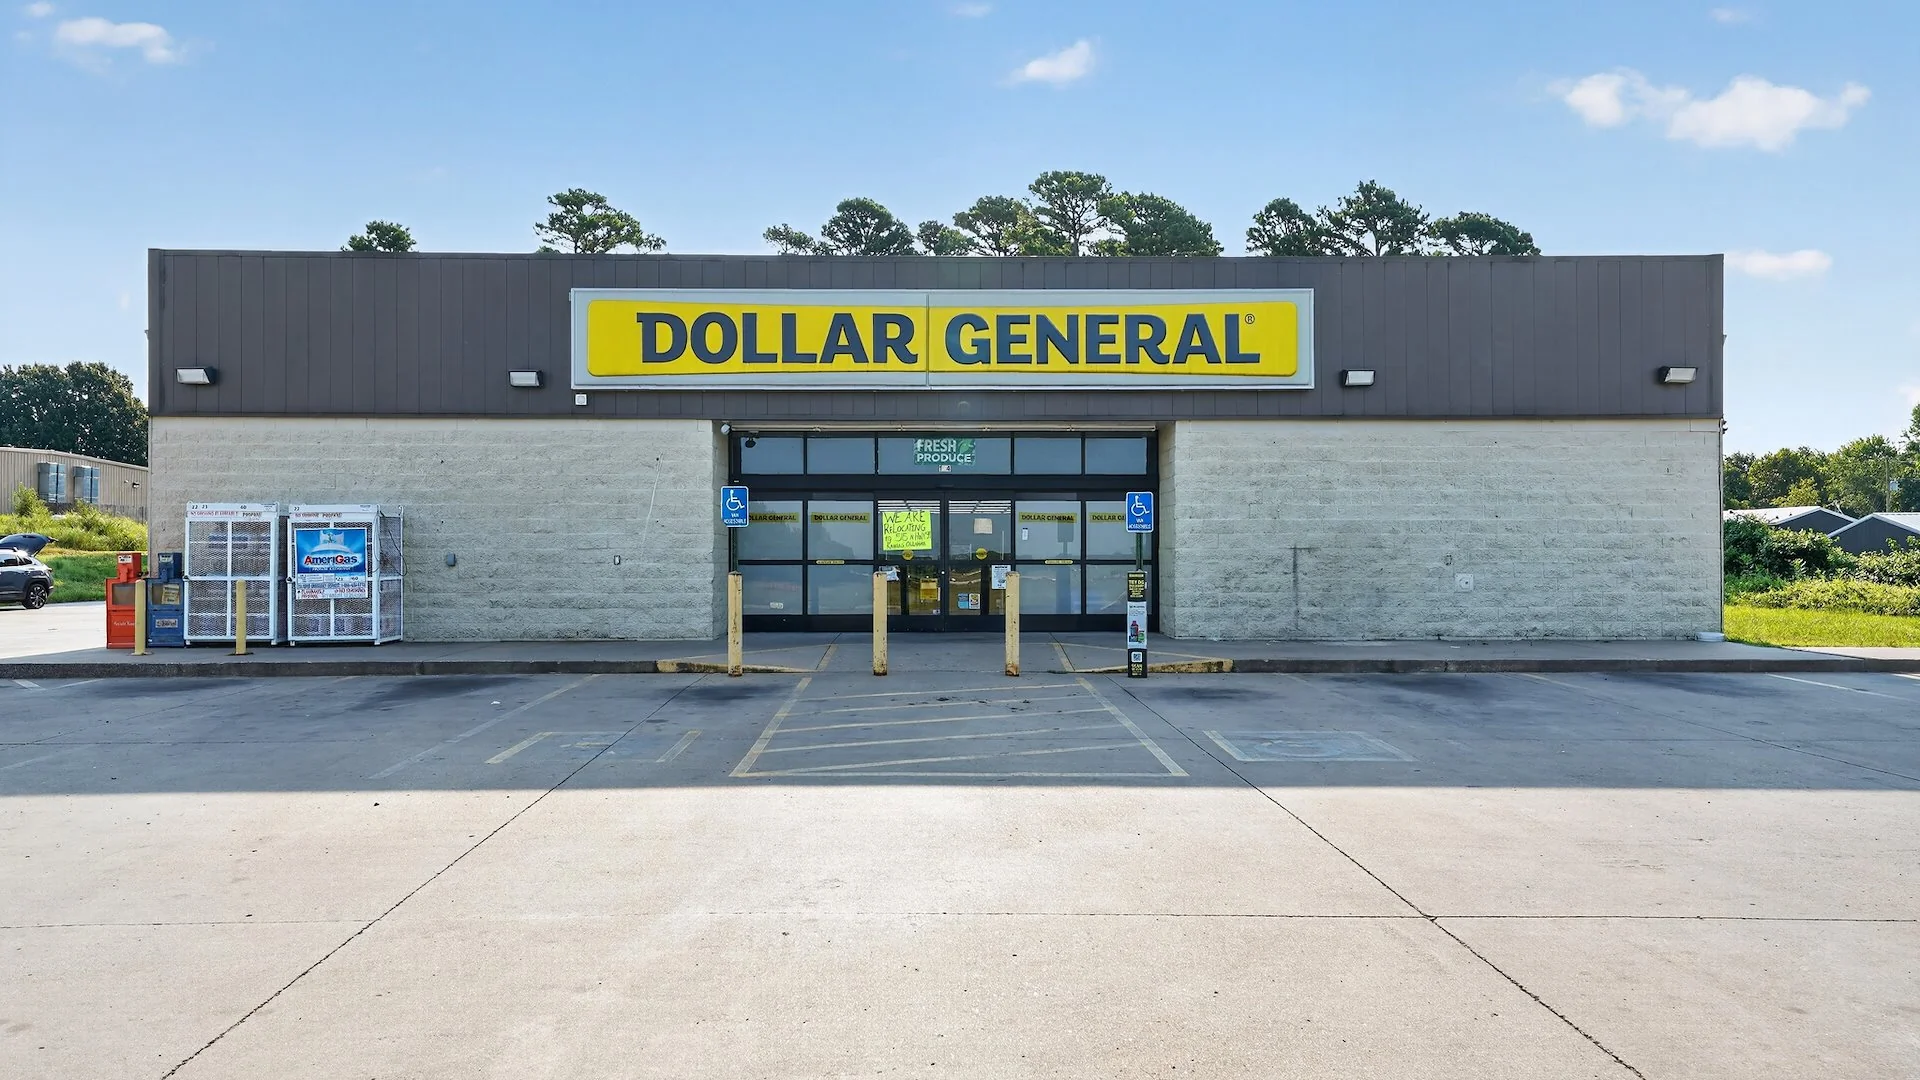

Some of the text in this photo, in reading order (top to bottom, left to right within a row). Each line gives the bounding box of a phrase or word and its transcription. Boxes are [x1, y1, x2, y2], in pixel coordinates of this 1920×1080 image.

[636, 311, 1261, 365] DOLLAR GENERAL
[917, 438, 957, 452] FRESH
[916, 453, 972, 463] PRODUCE
[884, 510, 926, 523] WE ARE
[304, 555, 358, 565] AmeriGas
